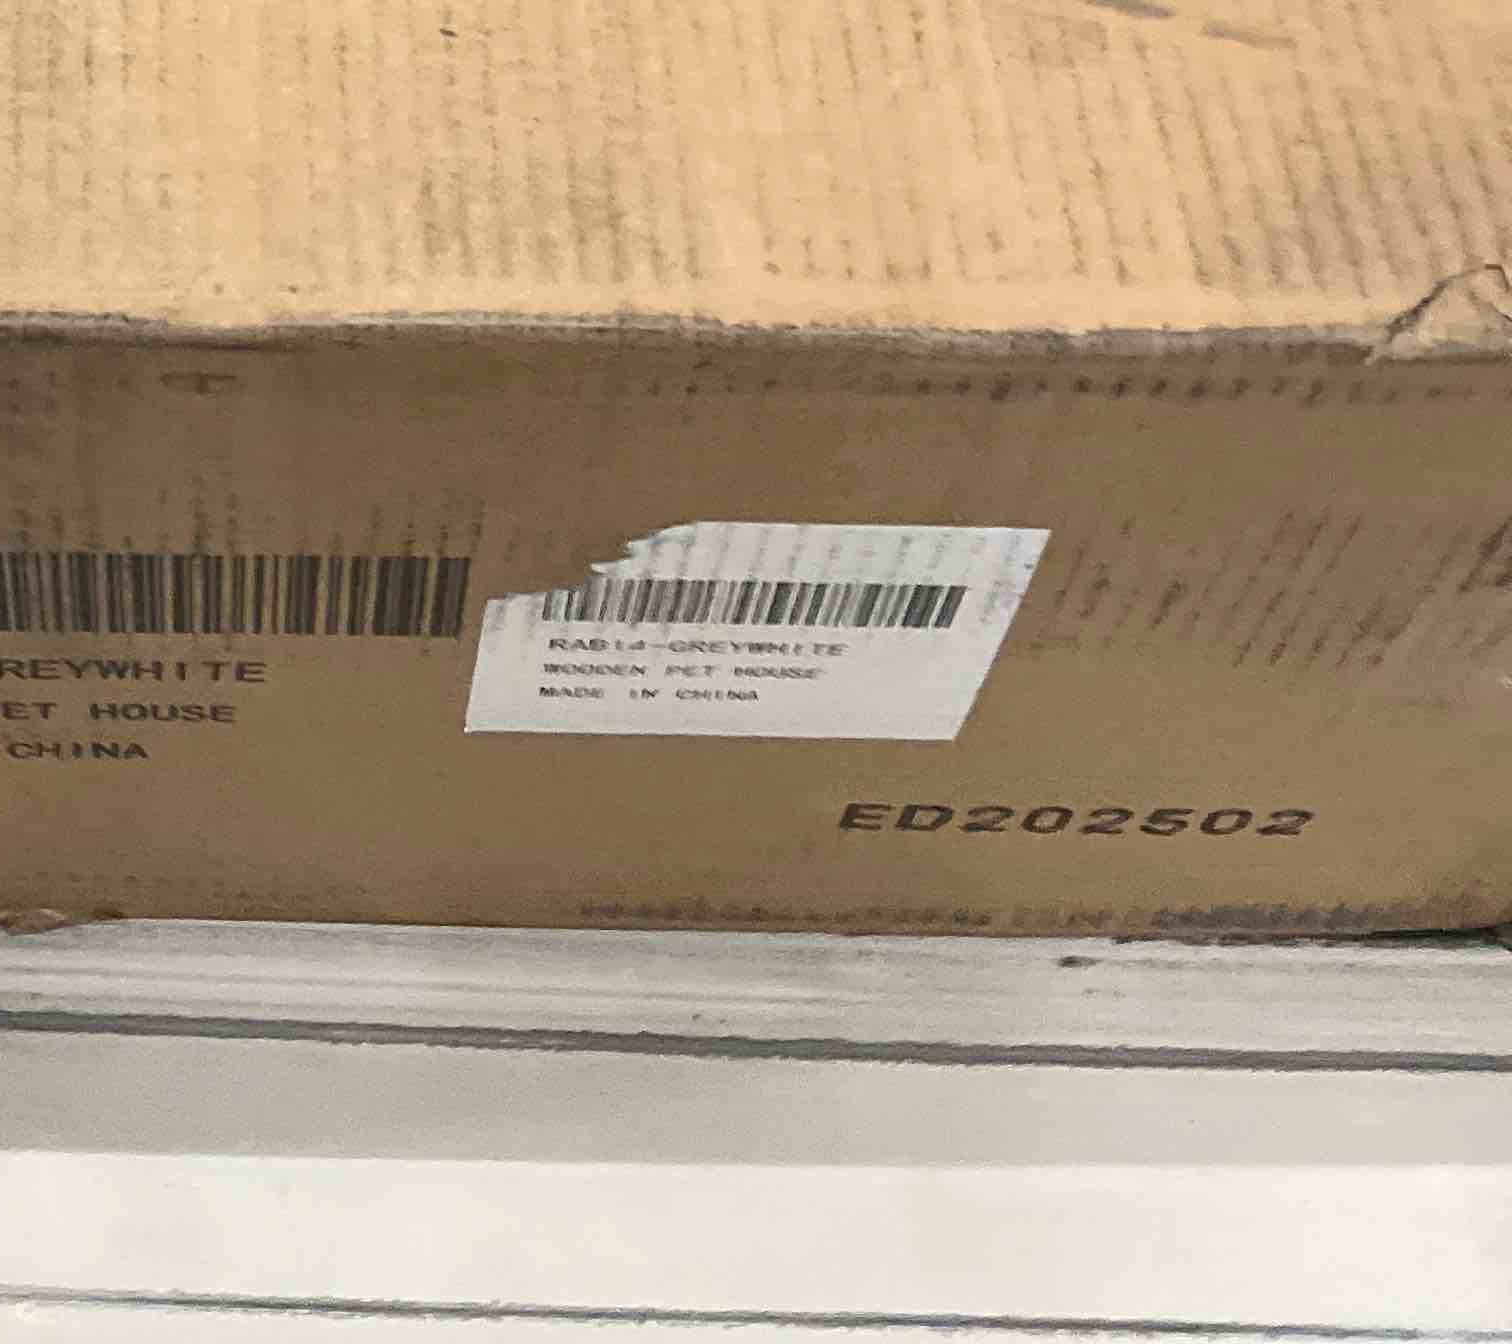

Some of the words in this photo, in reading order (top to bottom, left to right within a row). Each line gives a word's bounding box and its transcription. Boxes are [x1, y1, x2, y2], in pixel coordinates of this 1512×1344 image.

[89, 702, 238, 723] HOUSE
[8, 740, 150, 761] CHINA
[837, 801, 1316, 837] ED202502
